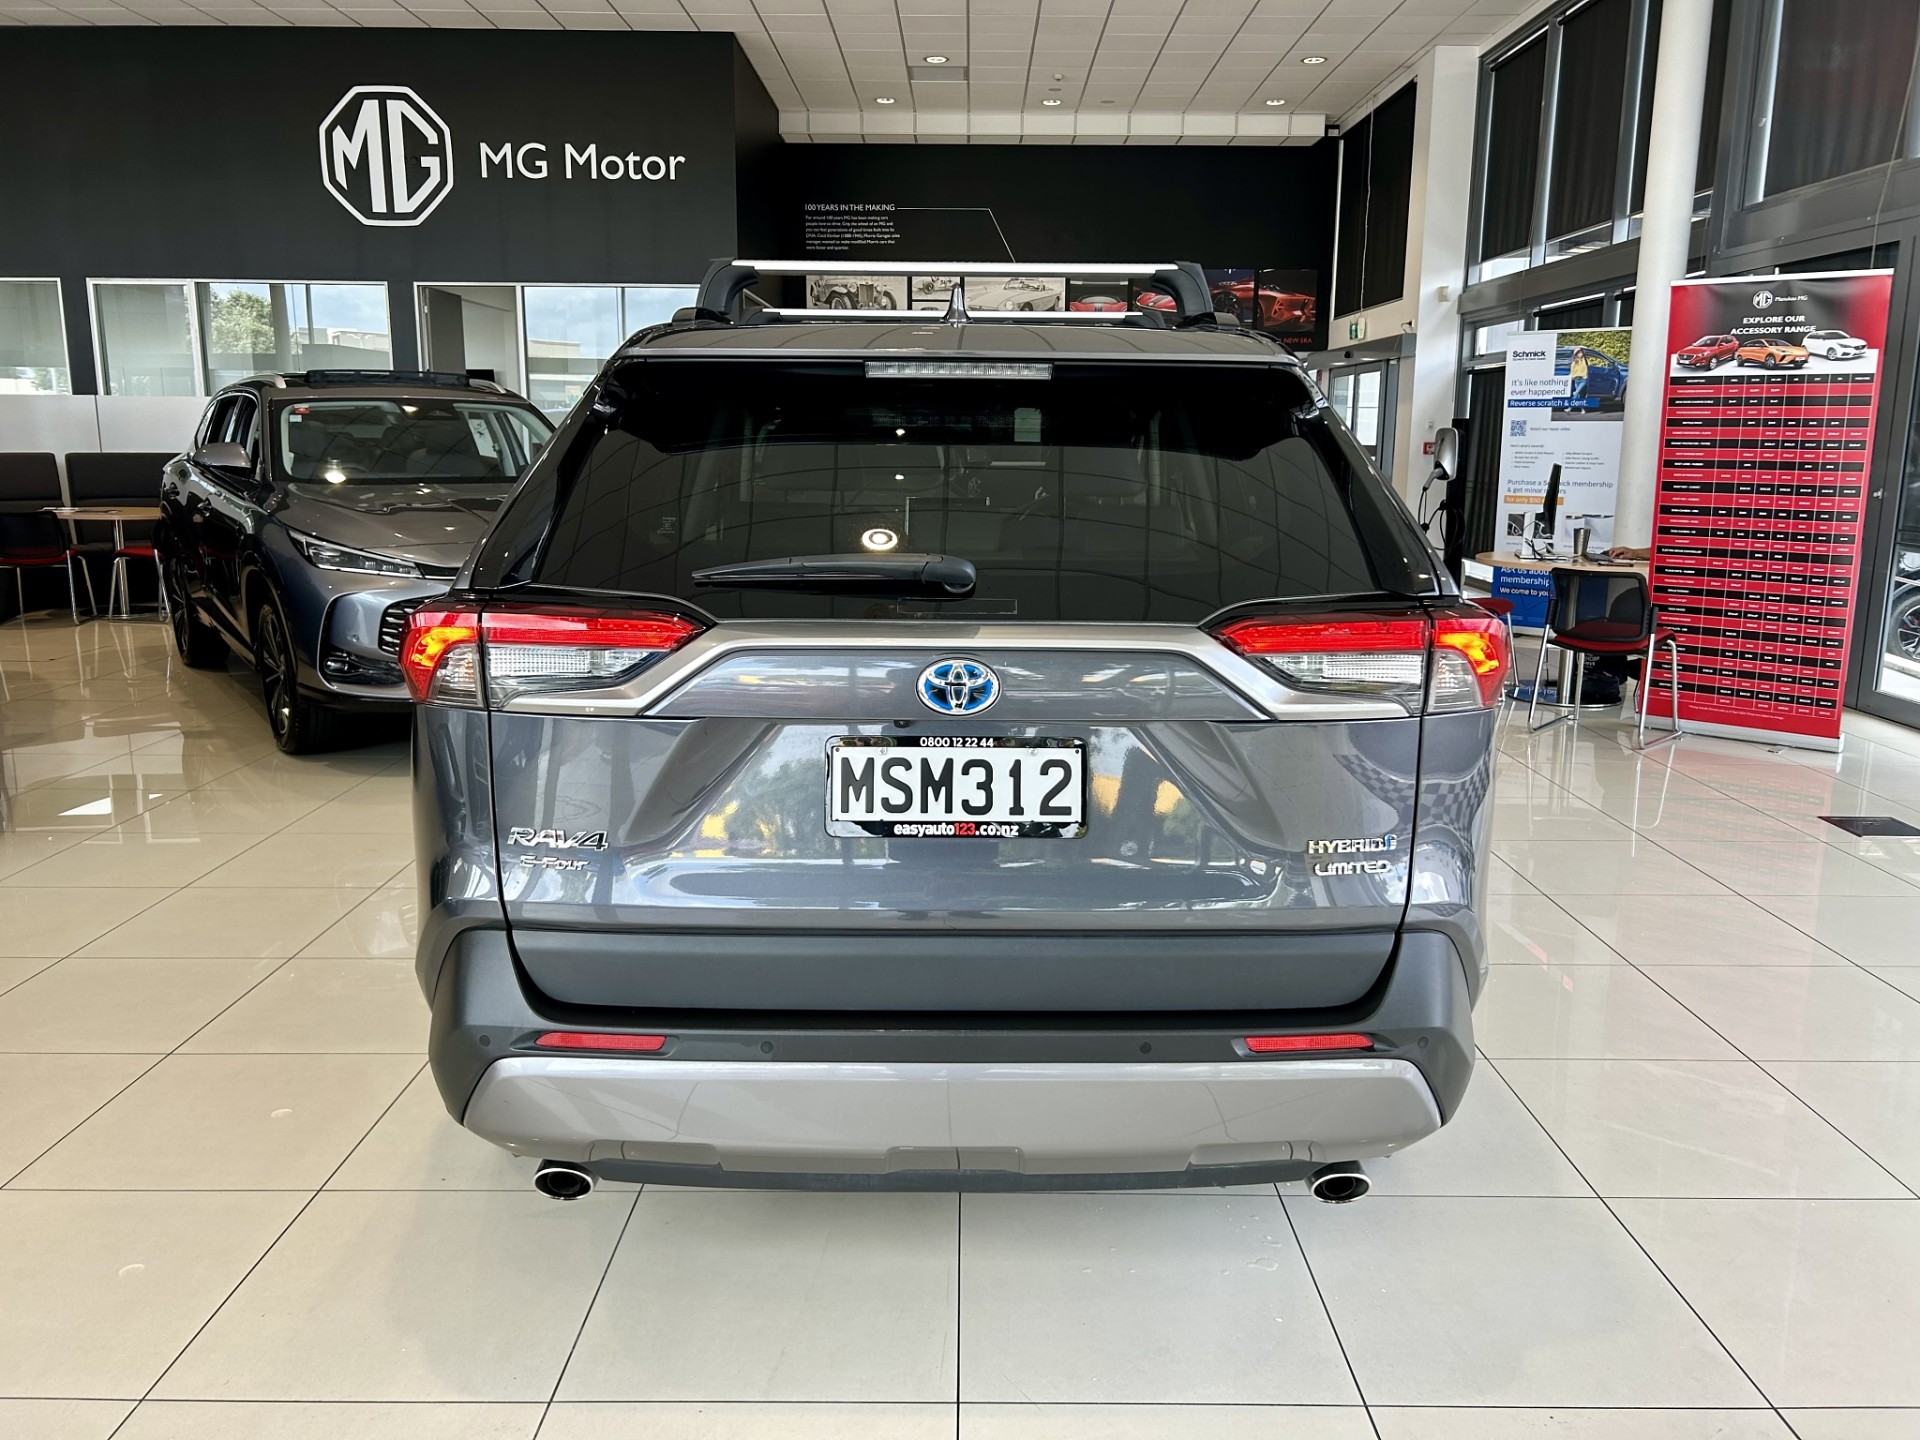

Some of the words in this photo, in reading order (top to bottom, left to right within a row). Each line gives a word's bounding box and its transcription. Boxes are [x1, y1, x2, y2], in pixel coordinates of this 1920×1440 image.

[331, 98, 442, 214] MG
[479, 142, 548, 179] MG
[564, 142, 686, 180] Motor
[804, 203, 816, 211] 100
[816, 203, 839, 211] YEARS
[840, 203, 849, 211] IN
[849, 203, 864, 211] THE
[865, 203, 895, 211] MAKING
[1753, 291, 1773, 309] MG
[1742, 316, 1783, 325] EXPLORE
[1784, 315, 1805, 323] OUR
[1730, 326, 1783, 335] ACCESSORY
[1784, 325, 1817, 334] RANGE
[1512, 350, 1546, 358] Schmick
[1540, 379, 1569, 389] nothing
[1528, 388, 1568, 397] happened.
[1510, 399, 1536, 407] Reverse
[1572, 480, 1613, 489] membership
[1512, 487, 1523, 495] get
[920, 737, 950, 748] 0800
[952, 737, 963, 748] 12
[965, 737, 978, 748] 22
[979, 737, 994, 748] 44
[840, 756, 1072, 816] MSM312
[893, 821, 1019, 838] easyauto123.co.nz
[507, 826, 610, 851] RAV4
[1308, 837, 1386, 854] HYBRID
[1314, 859, 1392, 876] LIMITED
